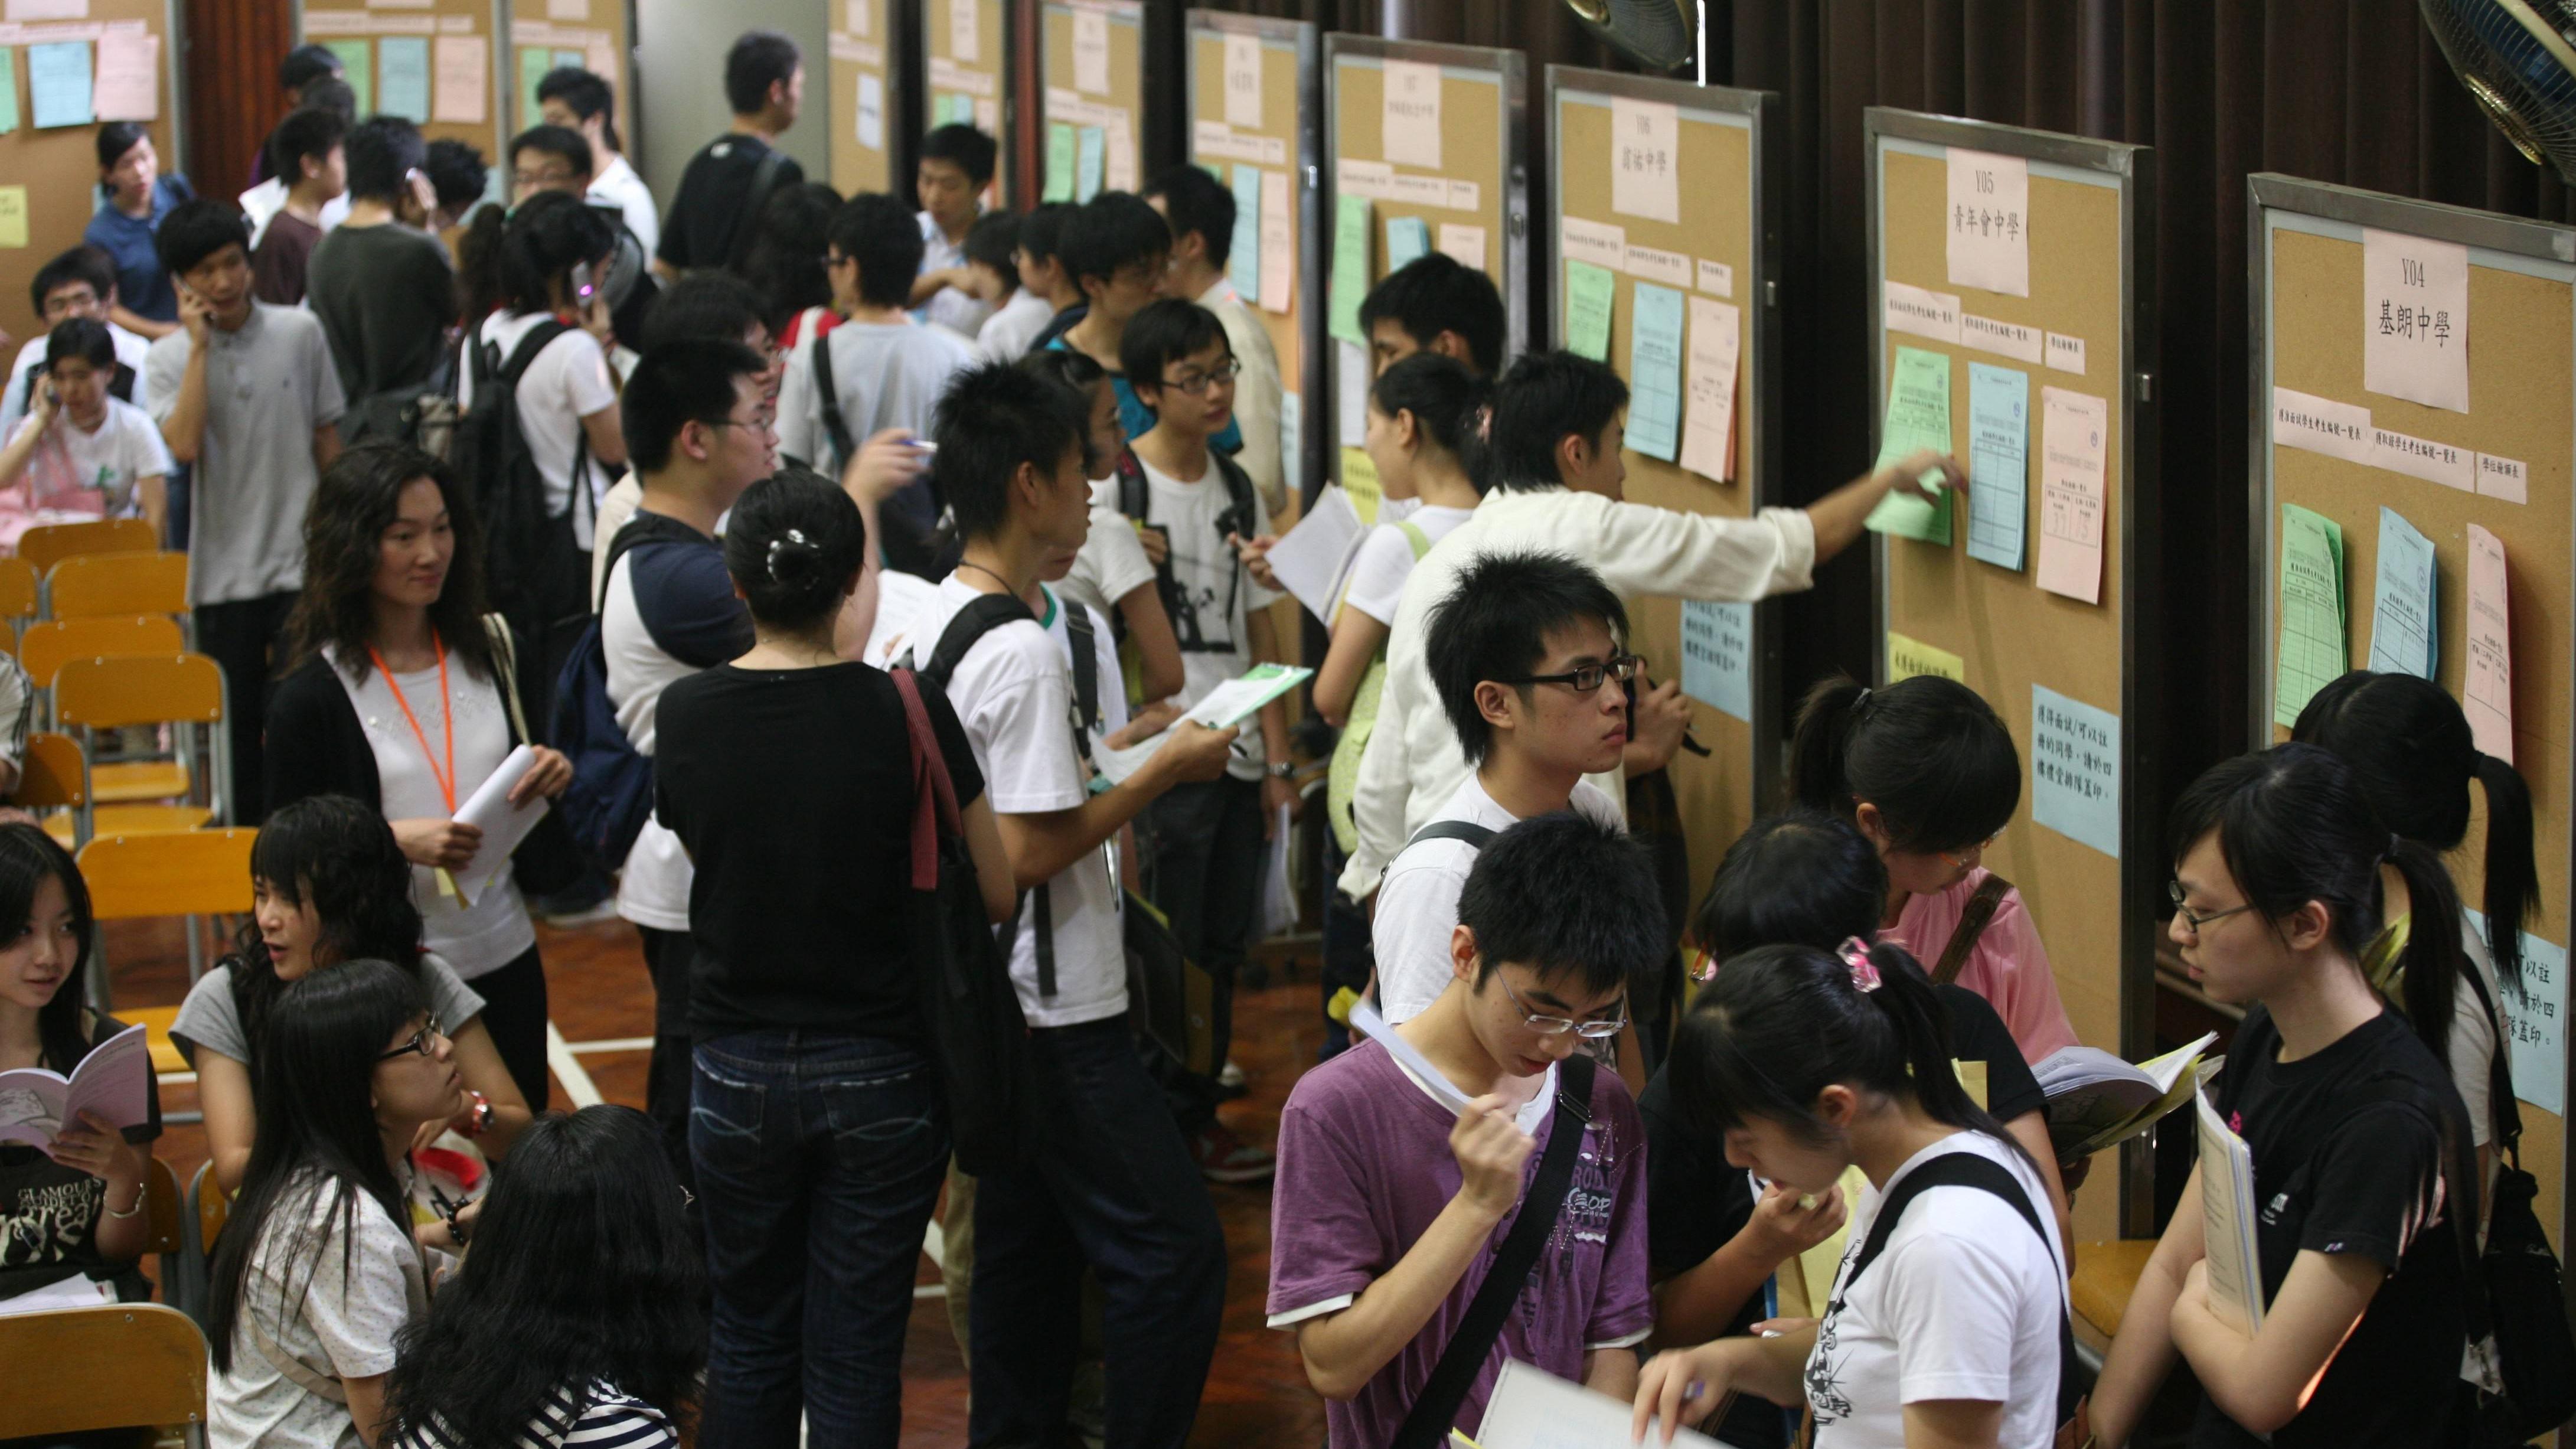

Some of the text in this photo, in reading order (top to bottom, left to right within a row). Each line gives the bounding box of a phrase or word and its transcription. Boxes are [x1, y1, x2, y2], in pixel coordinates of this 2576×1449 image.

[1975, 169, 1994, 194] Y05
[1954, 203, 2019, 242] 青年會中學
[2401, 257, 2425, 288] Y04
[2379, 300, 2451, 348] 基朗中學
